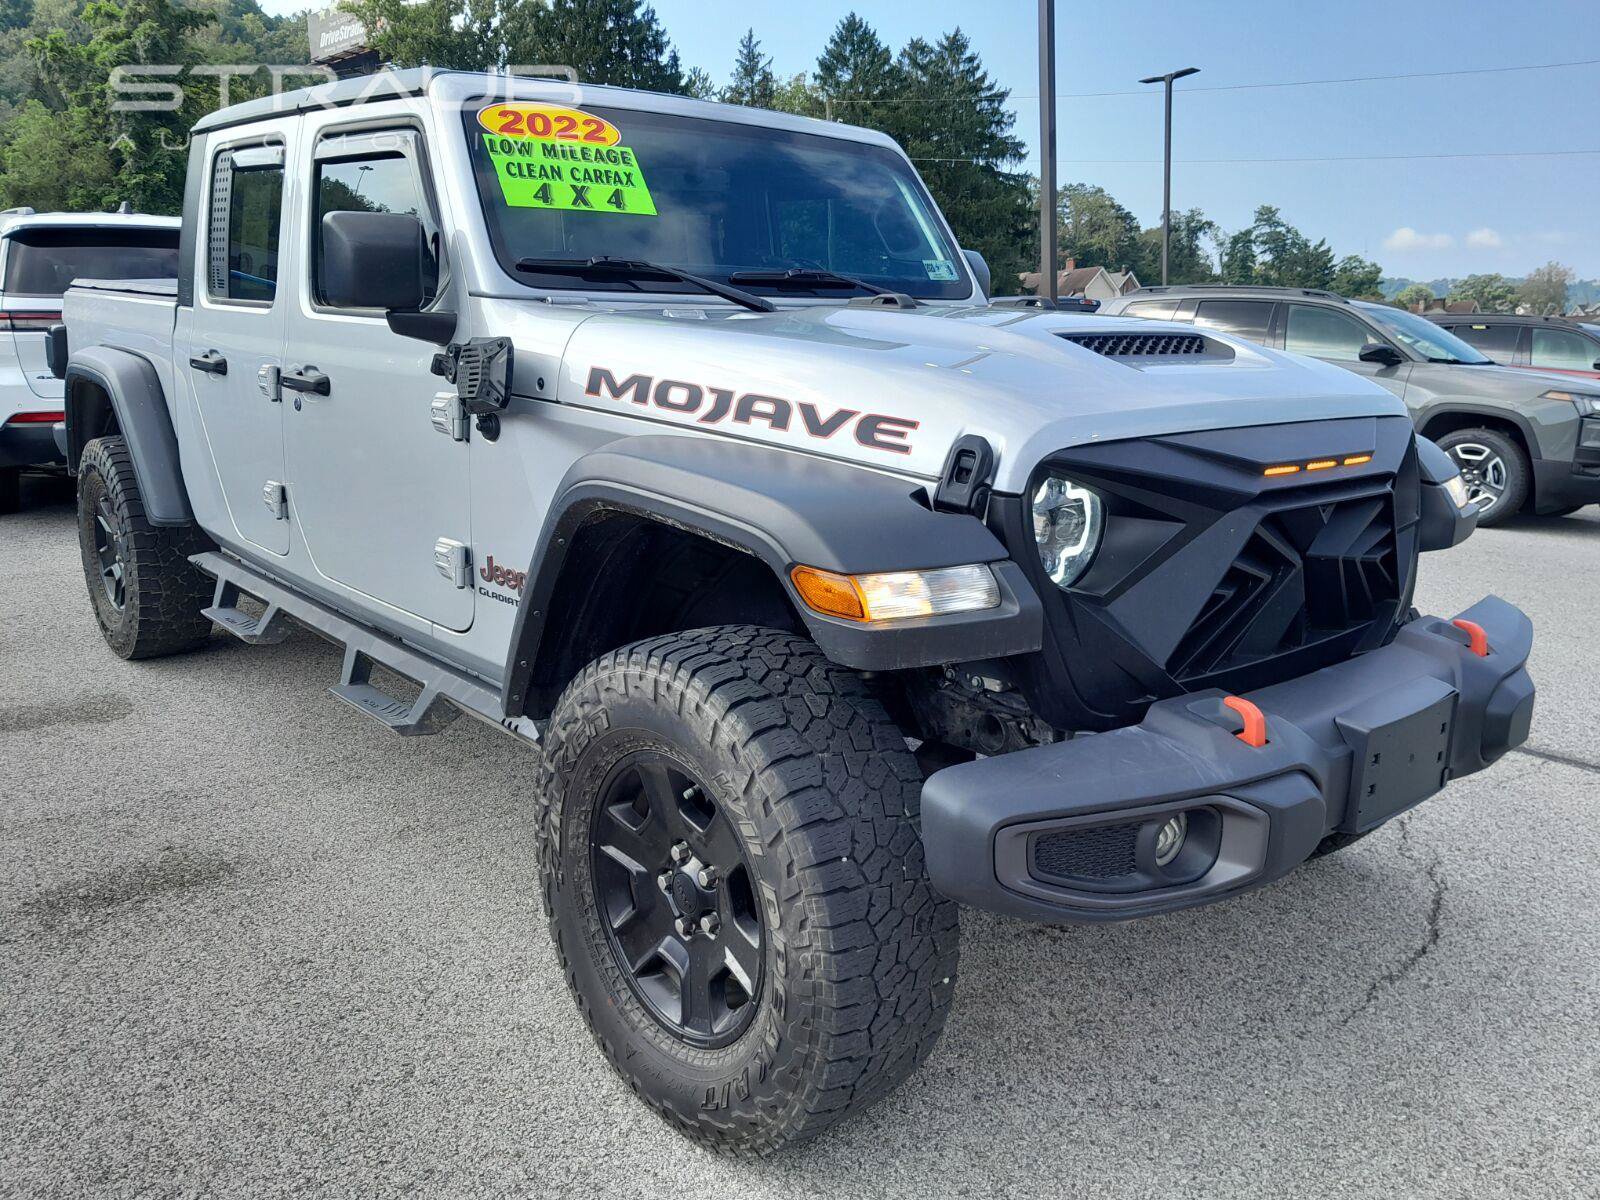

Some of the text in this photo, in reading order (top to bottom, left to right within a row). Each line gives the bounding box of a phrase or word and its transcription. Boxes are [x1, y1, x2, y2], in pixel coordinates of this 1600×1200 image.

[497, 110, 608, 142] 2022
[488, 138, 532, 157] LOW
[505, 161, 635, 188] CLEAN CARFAX
[533, 182, 552, 204] 4
[607, 188, 625, 210] 4
[584, 366, 920, 455] MOJAVE
[479, 586, 521, 608] GLADIAT
